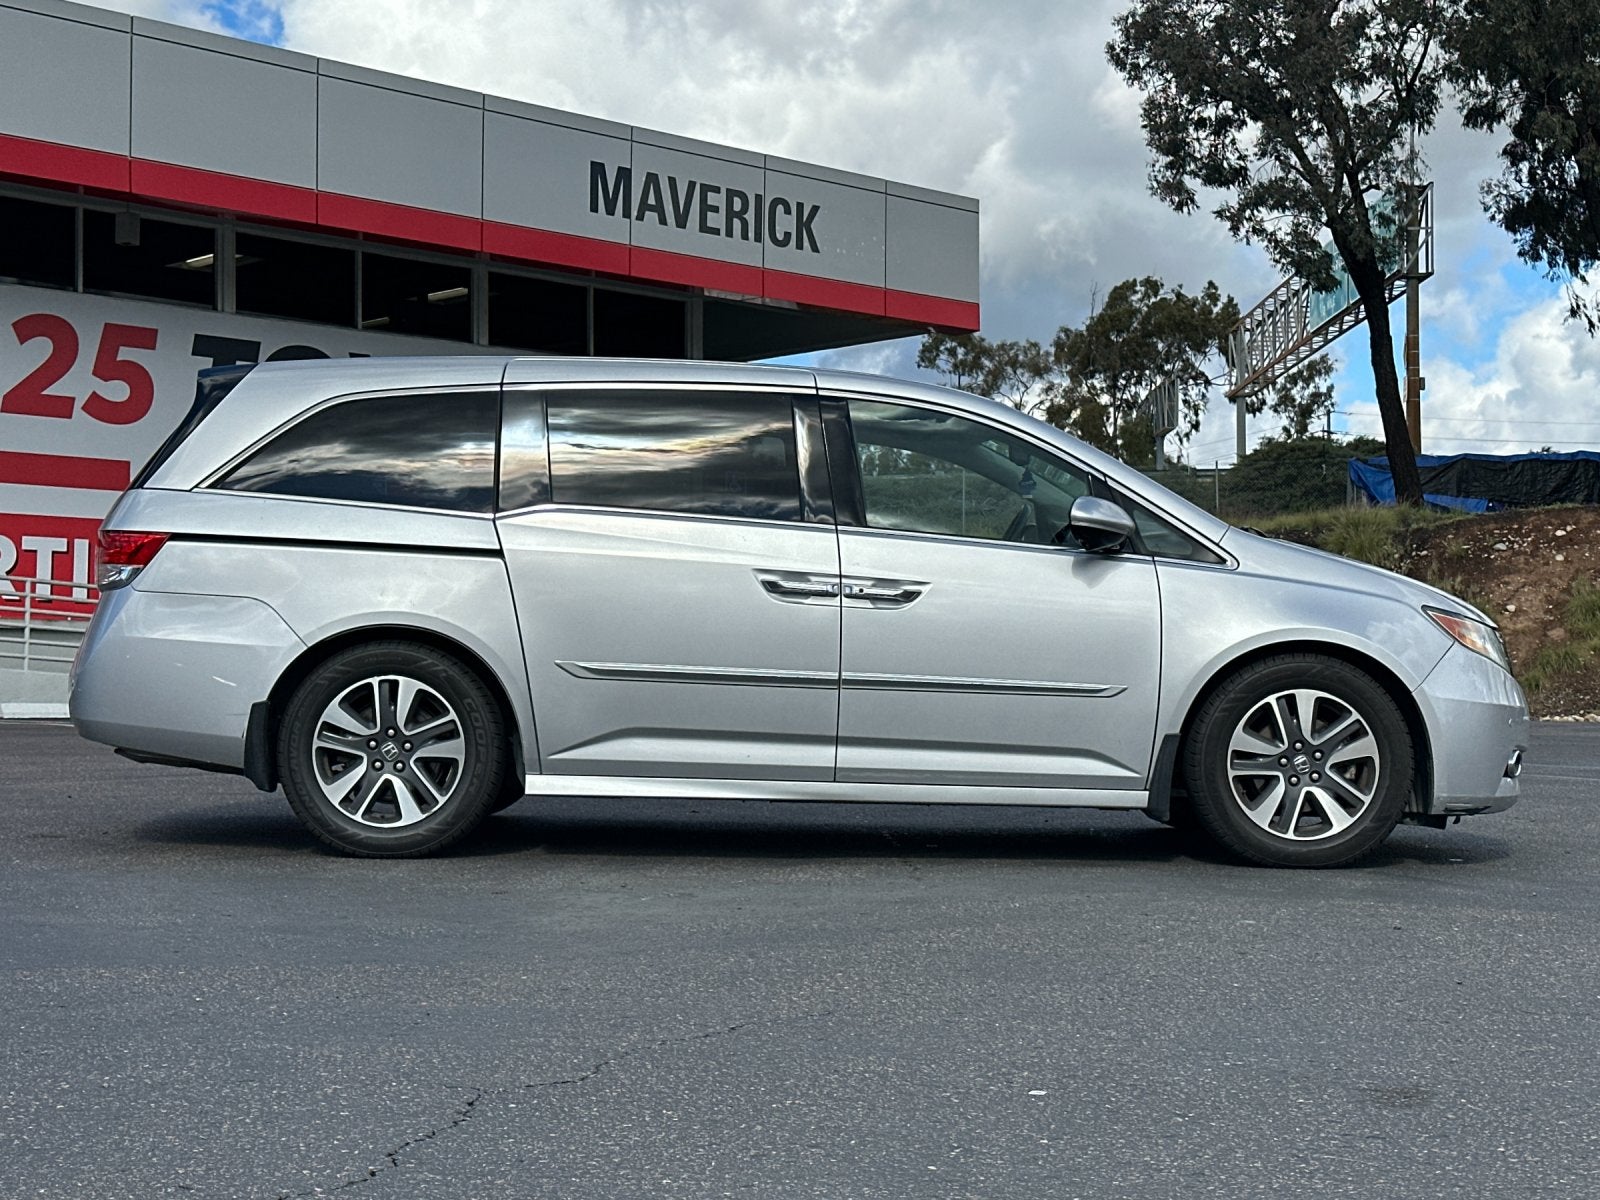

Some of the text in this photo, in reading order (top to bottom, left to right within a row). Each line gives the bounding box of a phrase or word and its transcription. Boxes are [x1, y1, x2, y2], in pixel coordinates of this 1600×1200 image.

[590, 160, 820, 254] MAVERICK
[1, 313, 158, 425] 25
[462, 697, 488, 794] COOPER
